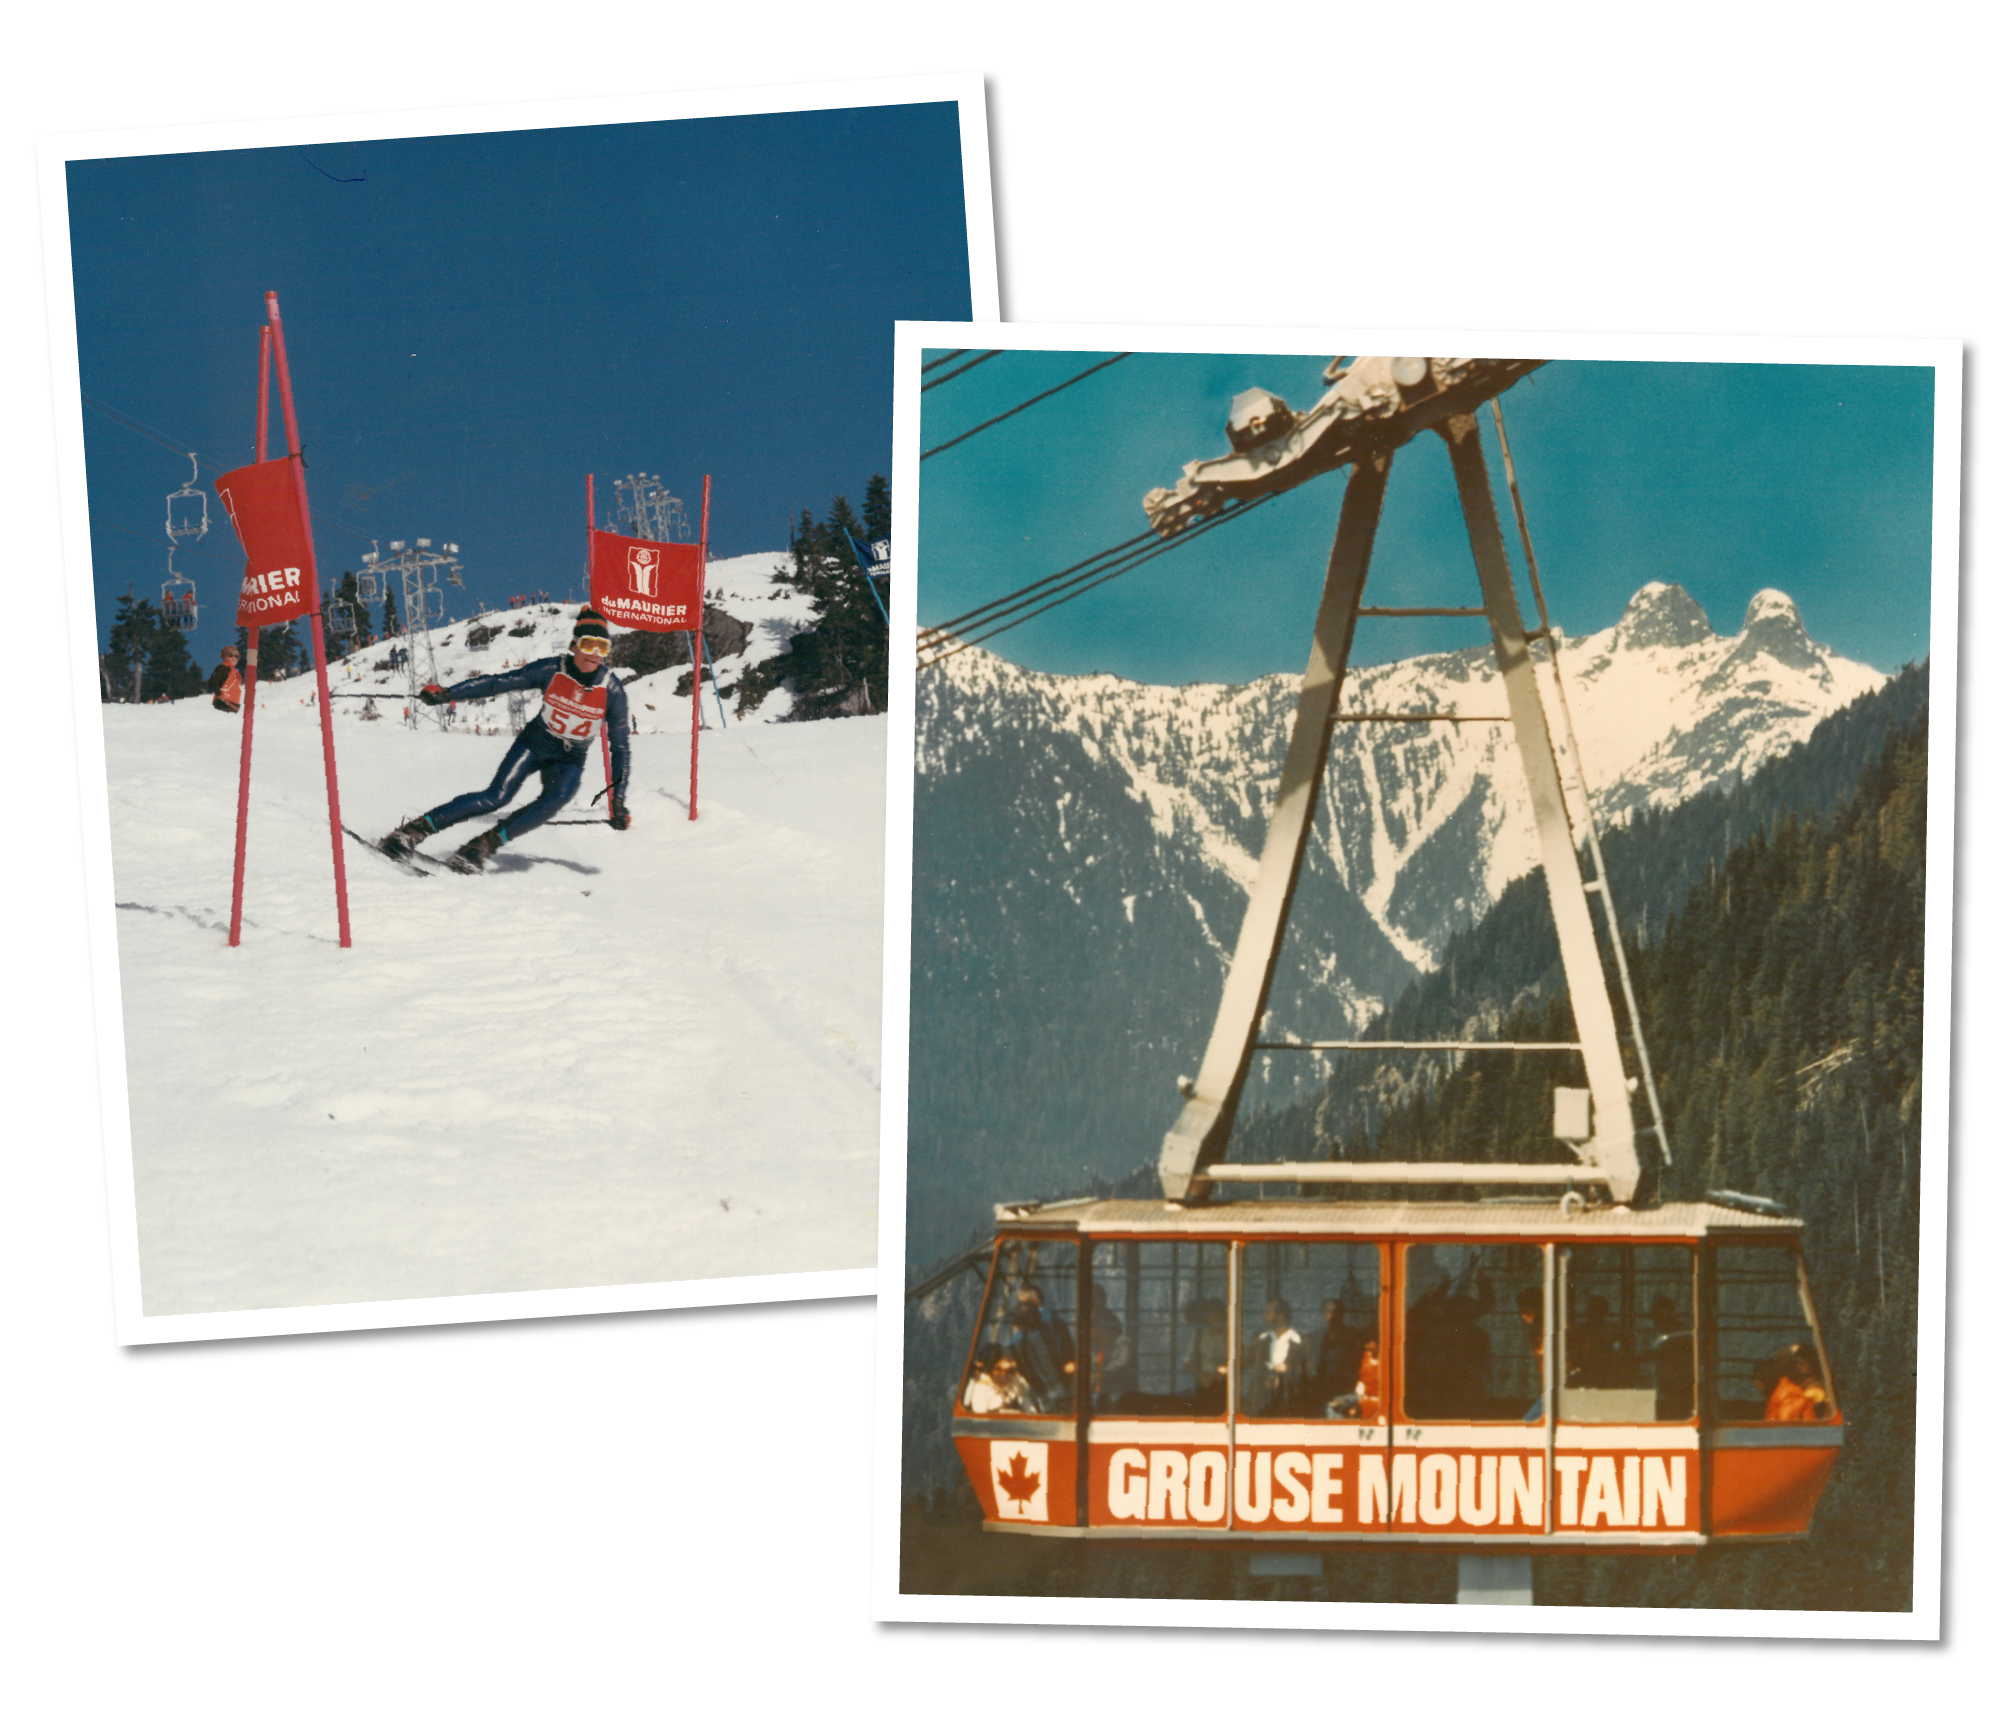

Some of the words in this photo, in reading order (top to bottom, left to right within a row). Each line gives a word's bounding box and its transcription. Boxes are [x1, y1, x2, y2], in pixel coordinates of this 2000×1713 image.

[603, 605, 687, 625] INTERNATIONAL
[548, 708, 592, 738] 54
[1108, 1448, 1343, 1523] GROUSE
[1358, 1453, 1686, 1527] MOUNTAIN
